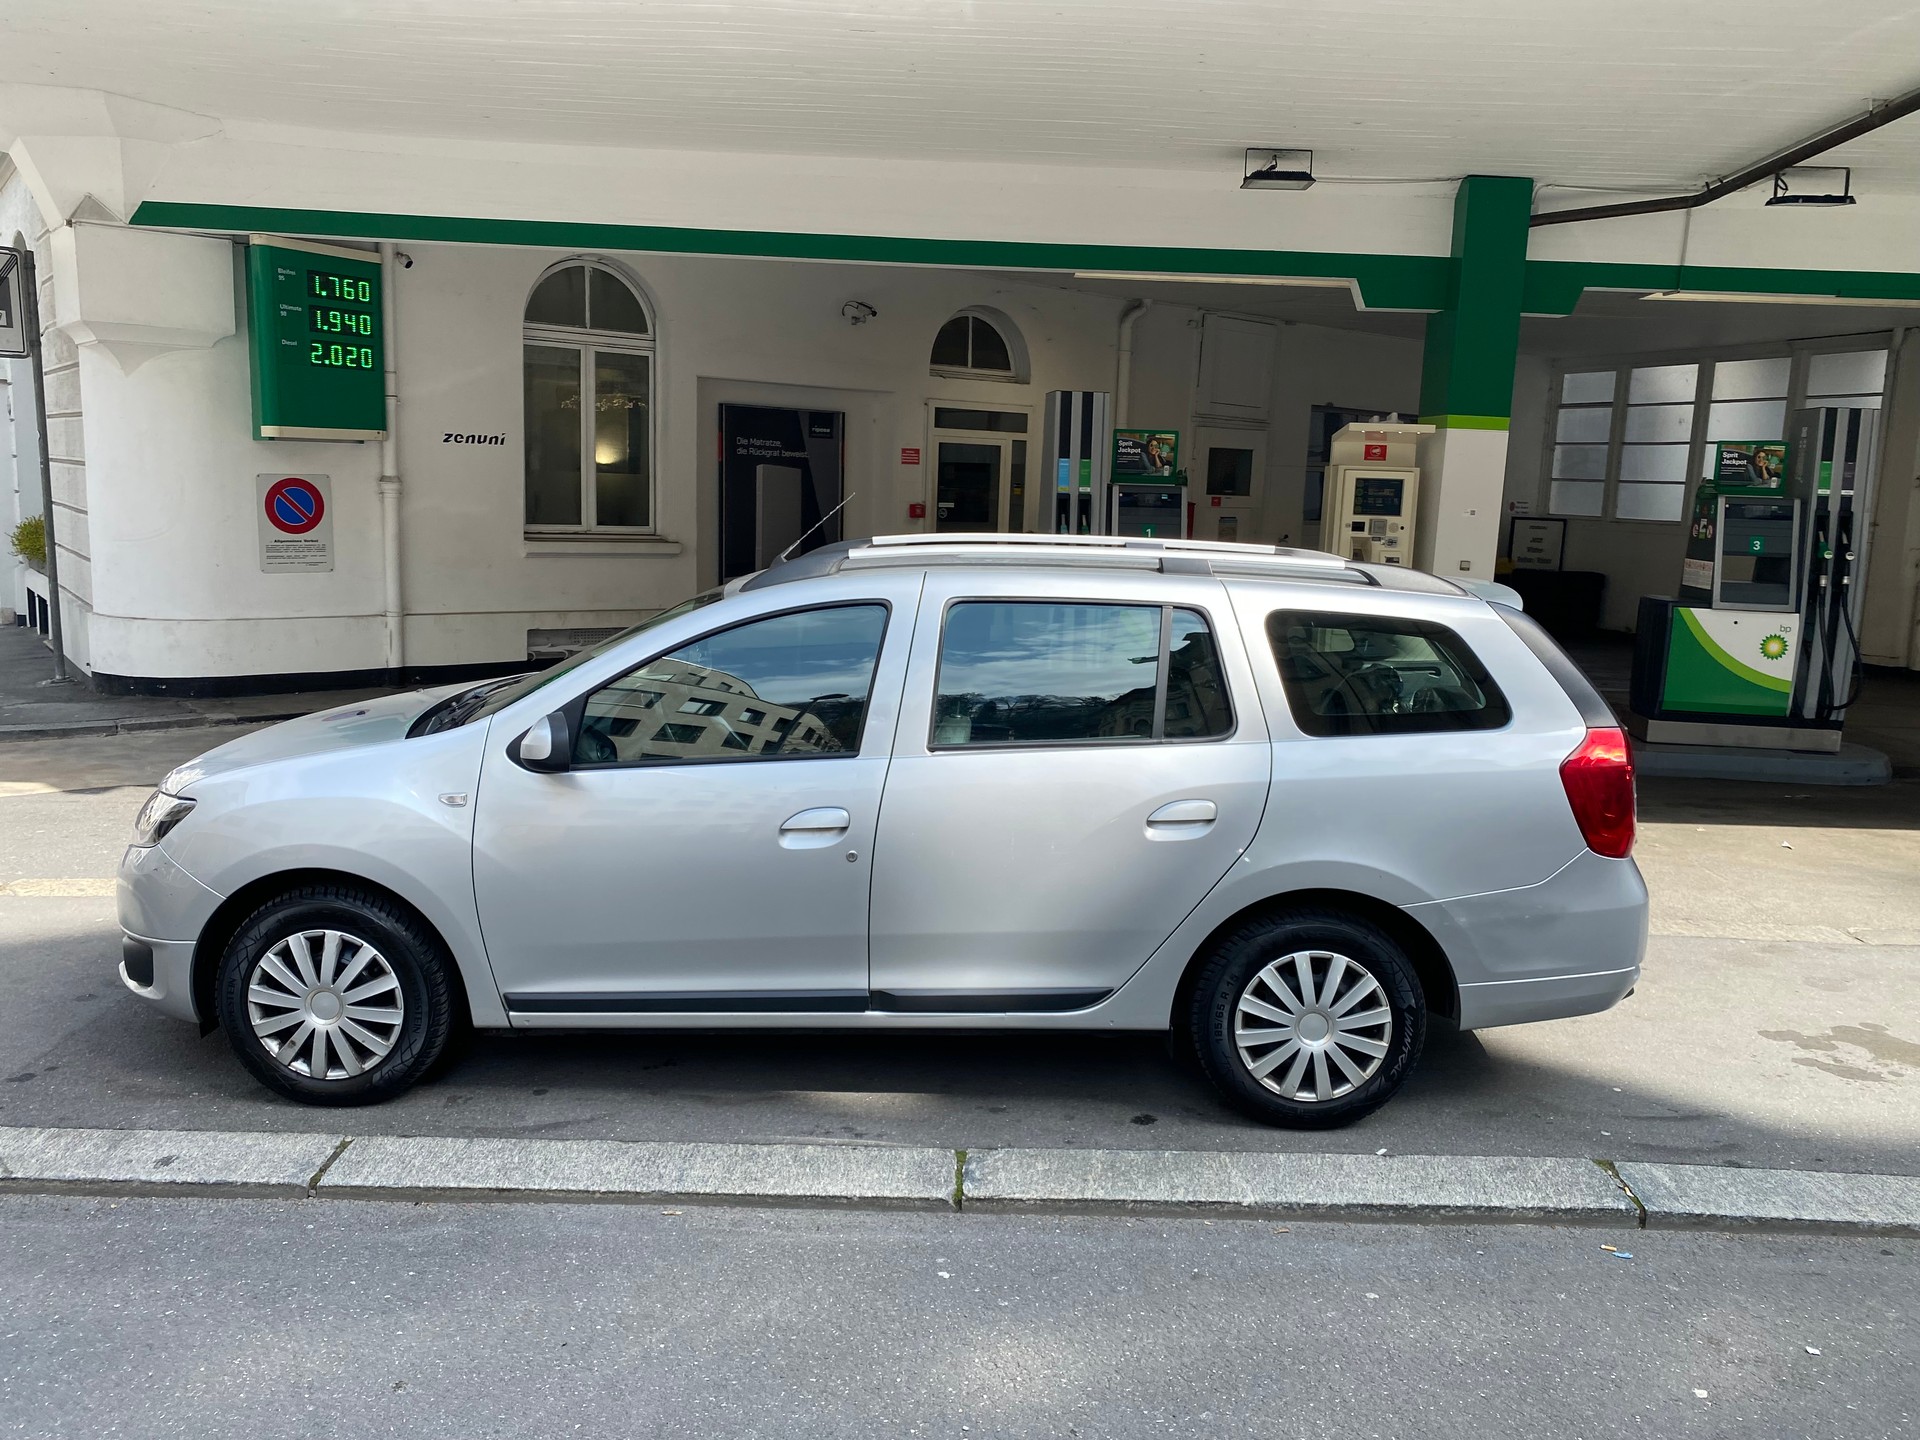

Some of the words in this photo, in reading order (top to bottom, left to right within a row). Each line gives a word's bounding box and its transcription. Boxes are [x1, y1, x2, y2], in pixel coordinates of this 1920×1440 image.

[314, 275, 370, 302] 1.760
[280, 303, 303, 312] Ultimate
[316, 310, 371, 335] 1.940
[281, 339, 298, 347] Diesel
[311, 343, 372, 368] 2.020
[442, 432, 506, 445] zenuni
[736, 436, 749, 445] Die
[749, 437, 783, 448] Matratze,
[1118, 440, 1133, 448] Sprit
[736, 446, 748, 455] die
[748, 447, 781, 458] Rückgrat
[1117, 447, 1142, 455] Jackpot
[1721, 451, 1739, 460] Sprit
[1721, 459, 1748, 467] Jackpot
[1145, 528, 1151, 538] 1
[1753, 540, 1761, 551] 3
[1779, 623, 1792, 635] bp
[1213, 1003, 1226, 1045] 185/65
[1220, 991, 1230, 1000] R
[1390, 1010, 1414, 1081] WINTRAC
